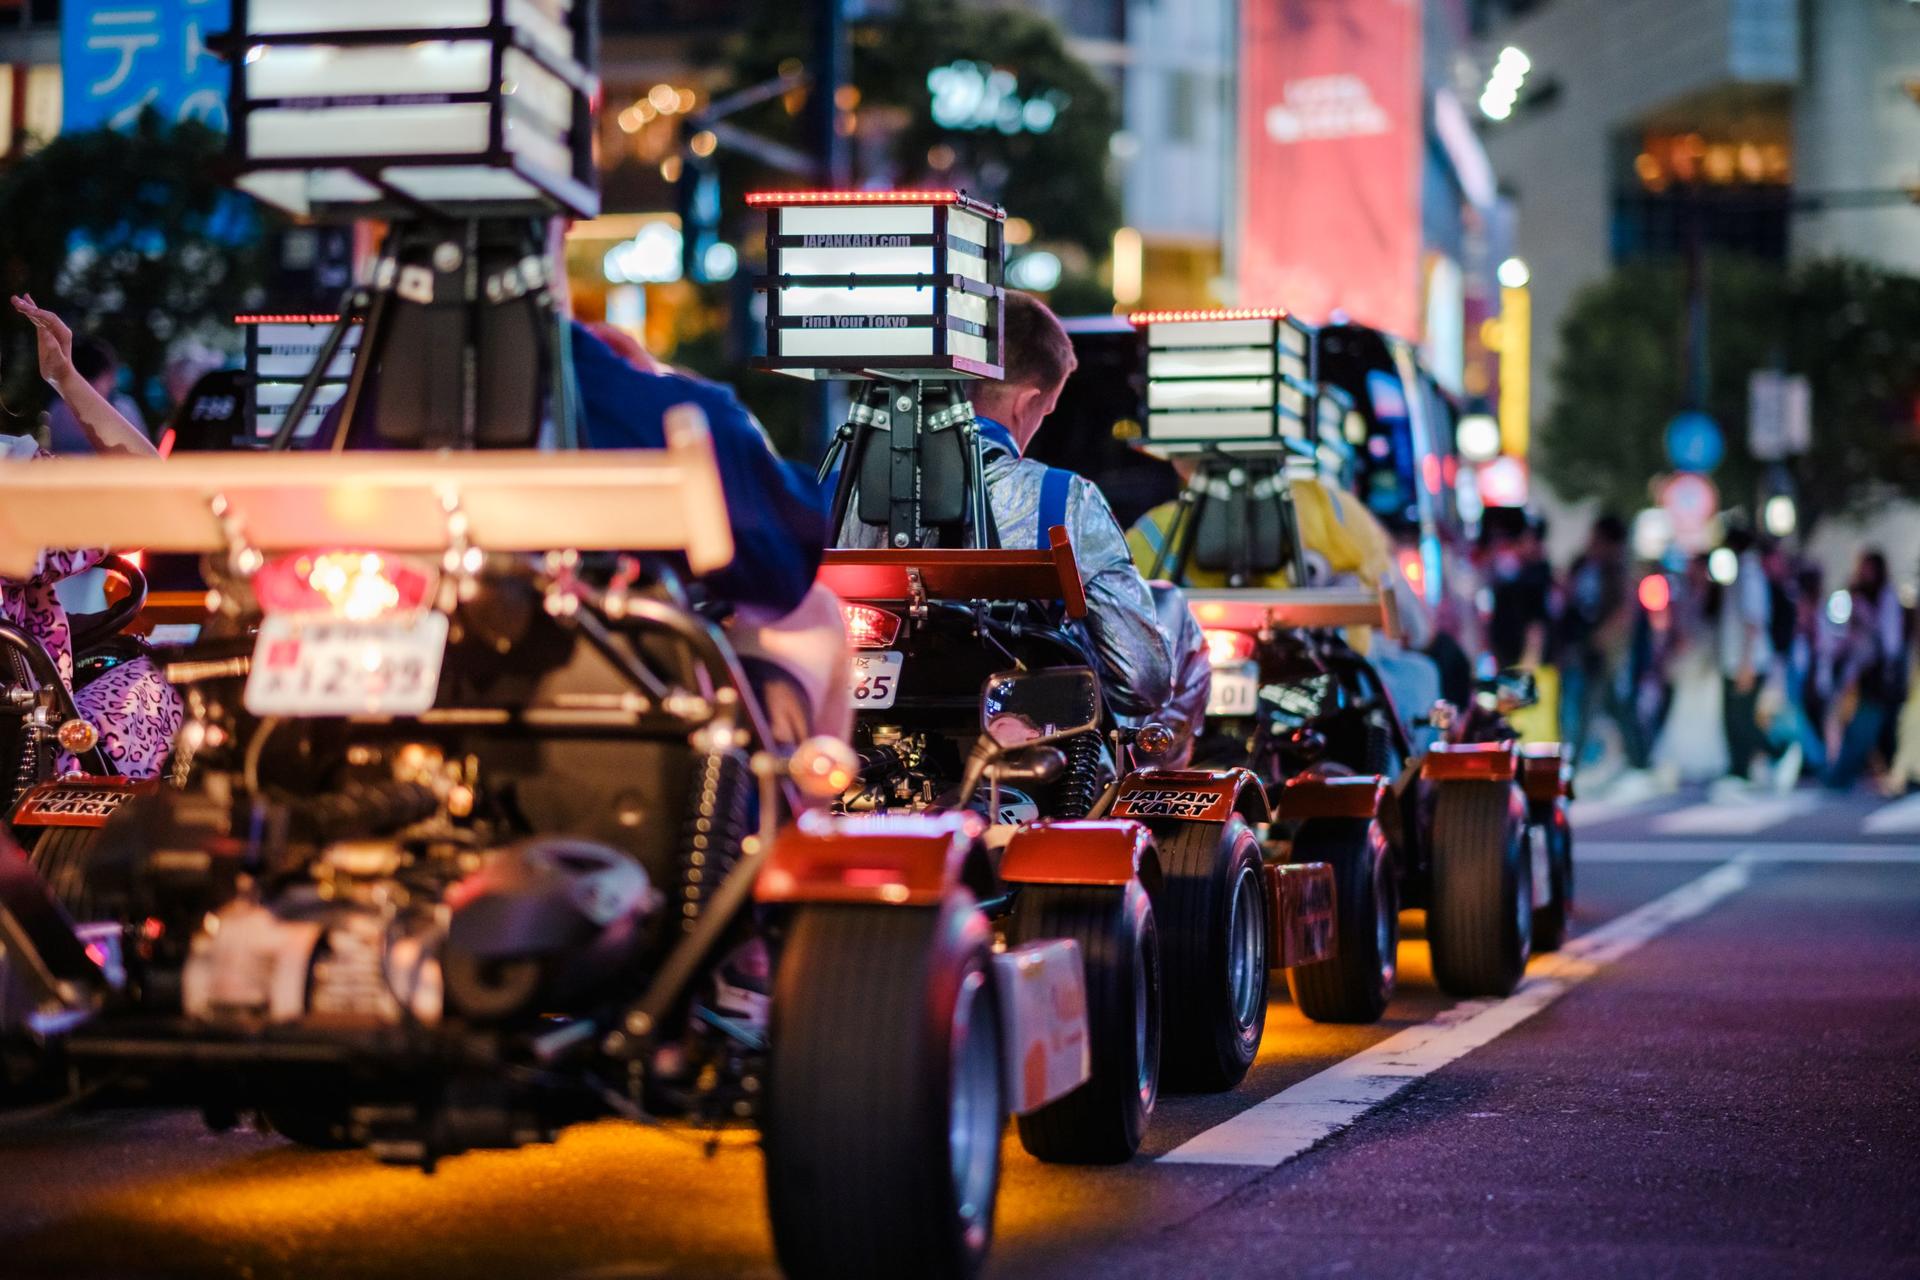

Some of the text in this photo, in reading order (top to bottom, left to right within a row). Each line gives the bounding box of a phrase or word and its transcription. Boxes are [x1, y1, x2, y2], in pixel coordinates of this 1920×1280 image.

[803, 234, 911, 249] JAPANKART.com
[802, 315, 908, 328] Find Your Tokyo
[30, 791, 135, 804] JAPAN
[1119, 790, 1222, 805] JAPAN
[32, 800, 118, 816] KART
[1126, 801, 1211, 817] KART
